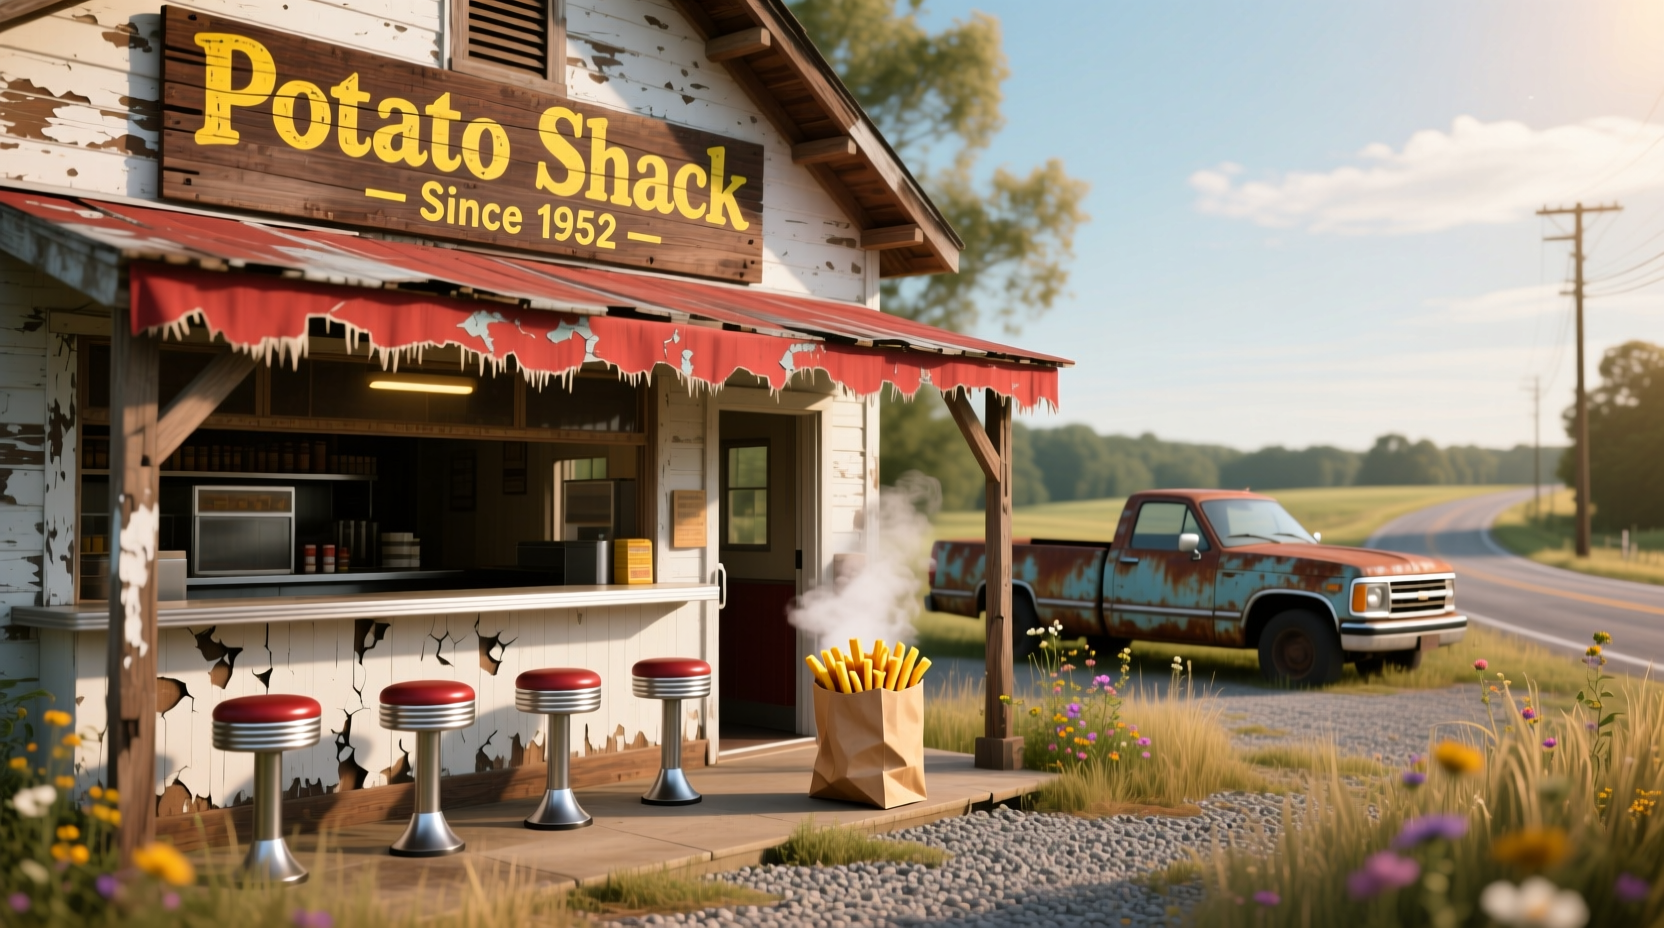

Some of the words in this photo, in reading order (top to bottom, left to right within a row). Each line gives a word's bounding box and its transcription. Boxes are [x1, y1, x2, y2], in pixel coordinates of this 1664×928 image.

[193, 32, 511, 181] Potato
[534, 105, 750, 231] Shack
[420, 181, 523, 235] Since
[538, 204, 617, 249] 1952
